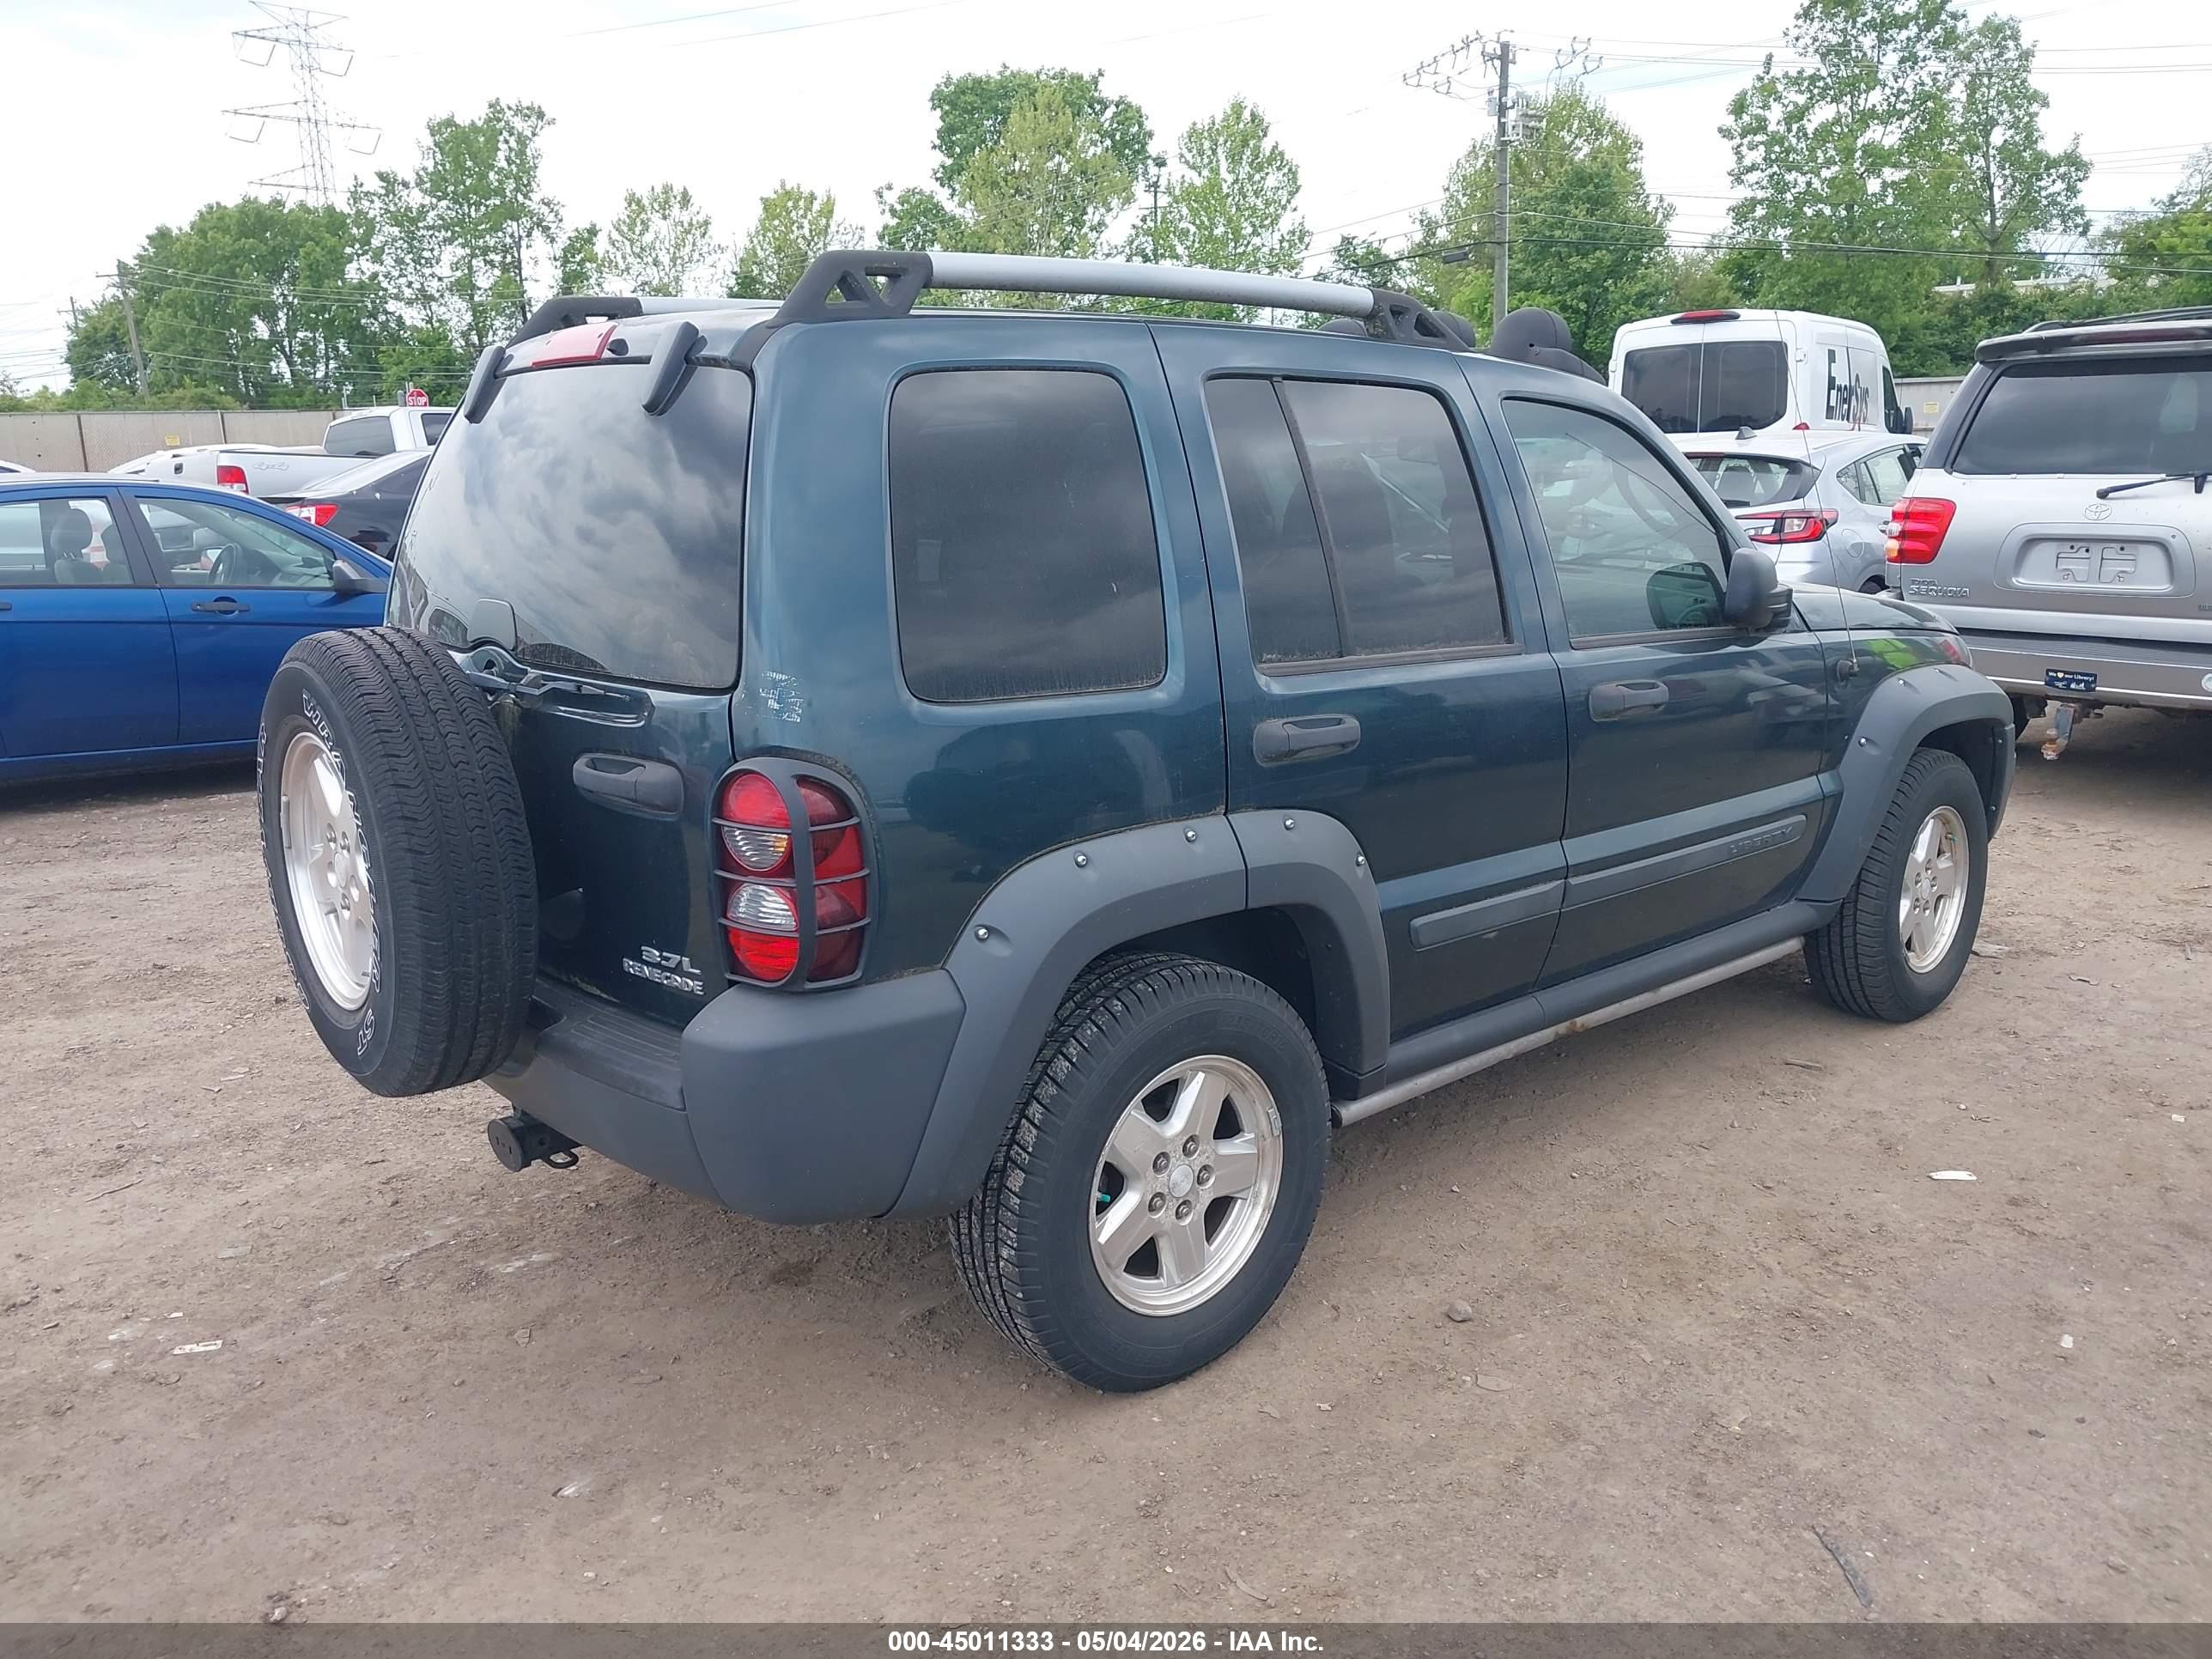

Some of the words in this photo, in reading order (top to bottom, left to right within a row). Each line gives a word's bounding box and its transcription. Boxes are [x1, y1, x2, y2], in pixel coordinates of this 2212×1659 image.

[408, 396, 427, 406] STOP
[1826, 349, 1869, 432] EnerSys
[1908, 585, 1971, 599] SEQUOIA
[622, 957, 705, 995] RENEGADE
